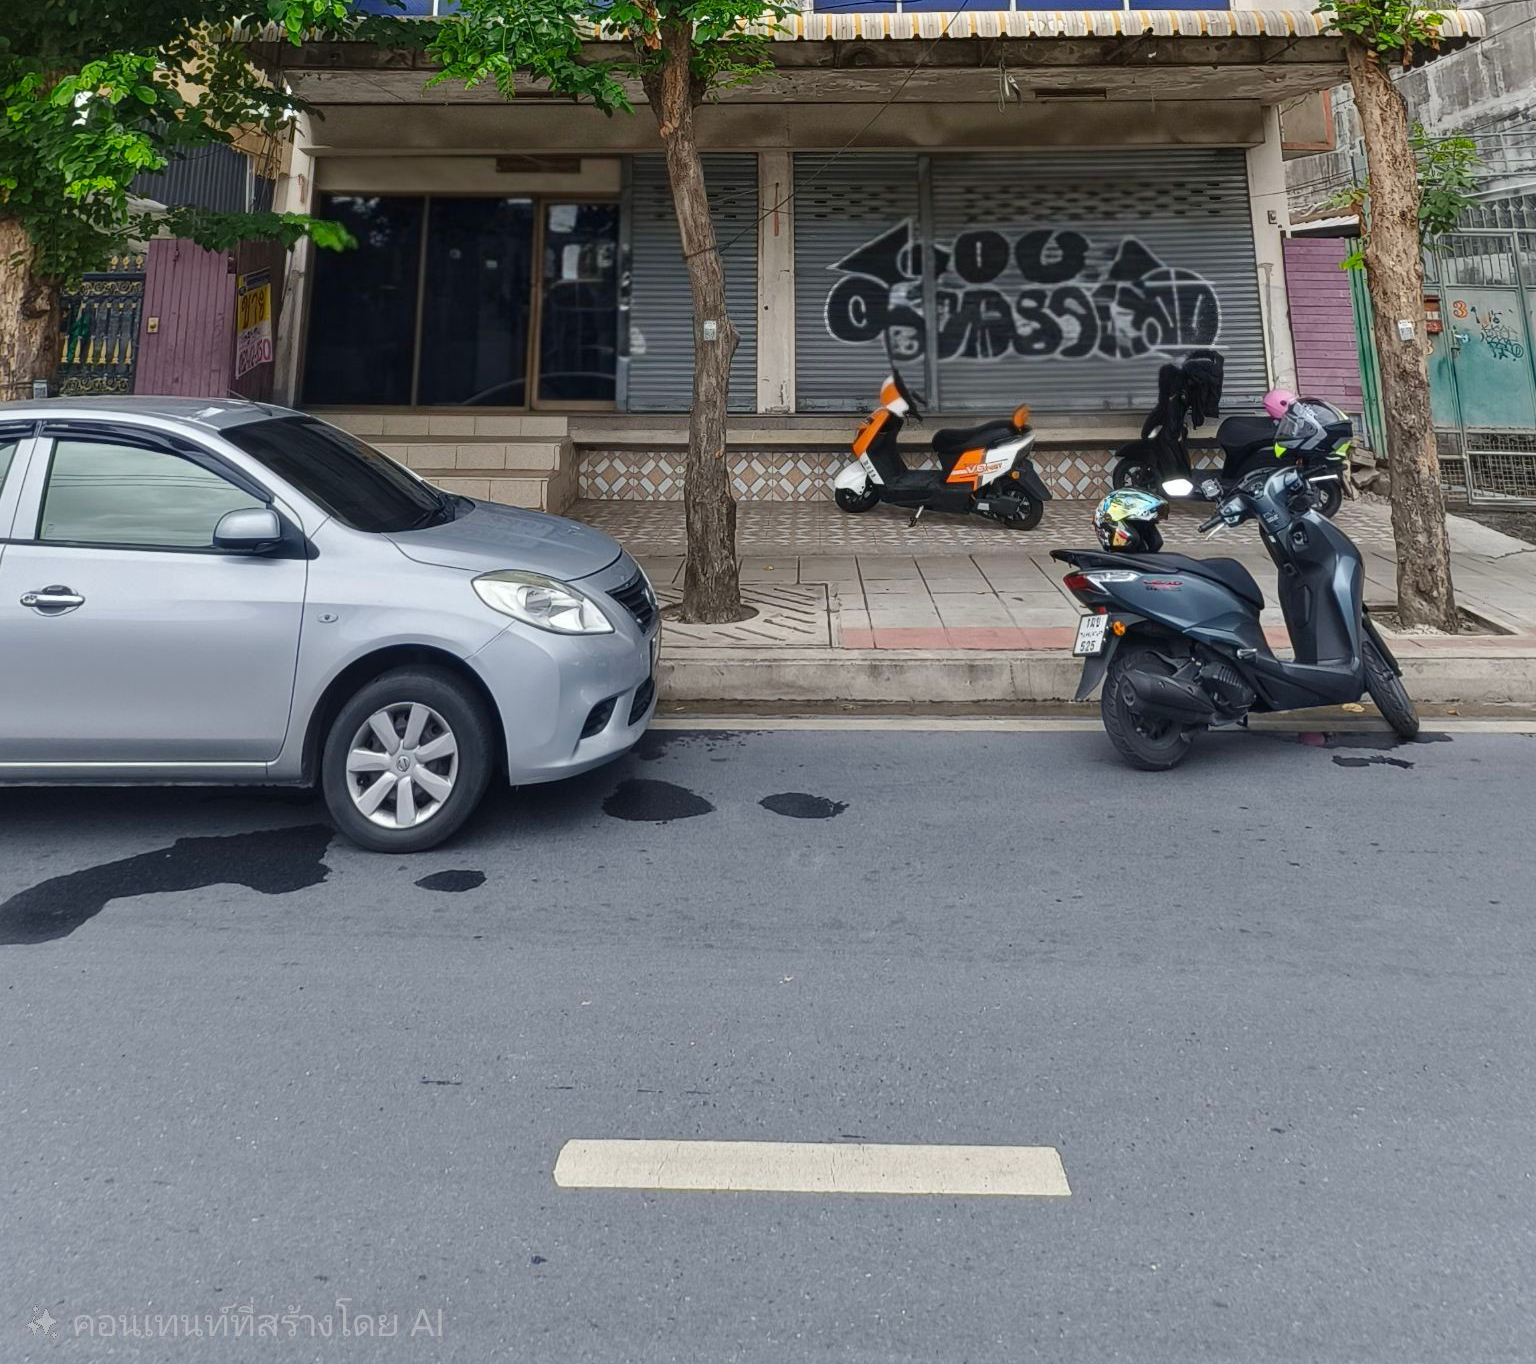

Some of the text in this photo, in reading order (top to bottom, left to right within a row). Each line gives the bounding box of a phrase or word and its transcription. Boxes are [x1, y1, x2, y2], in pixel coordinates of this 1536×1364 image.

[241, 292, 265, 329] ขาย
[1453, 300, 1468, 318] 3
[1080, 640, 1096, 652] 525
